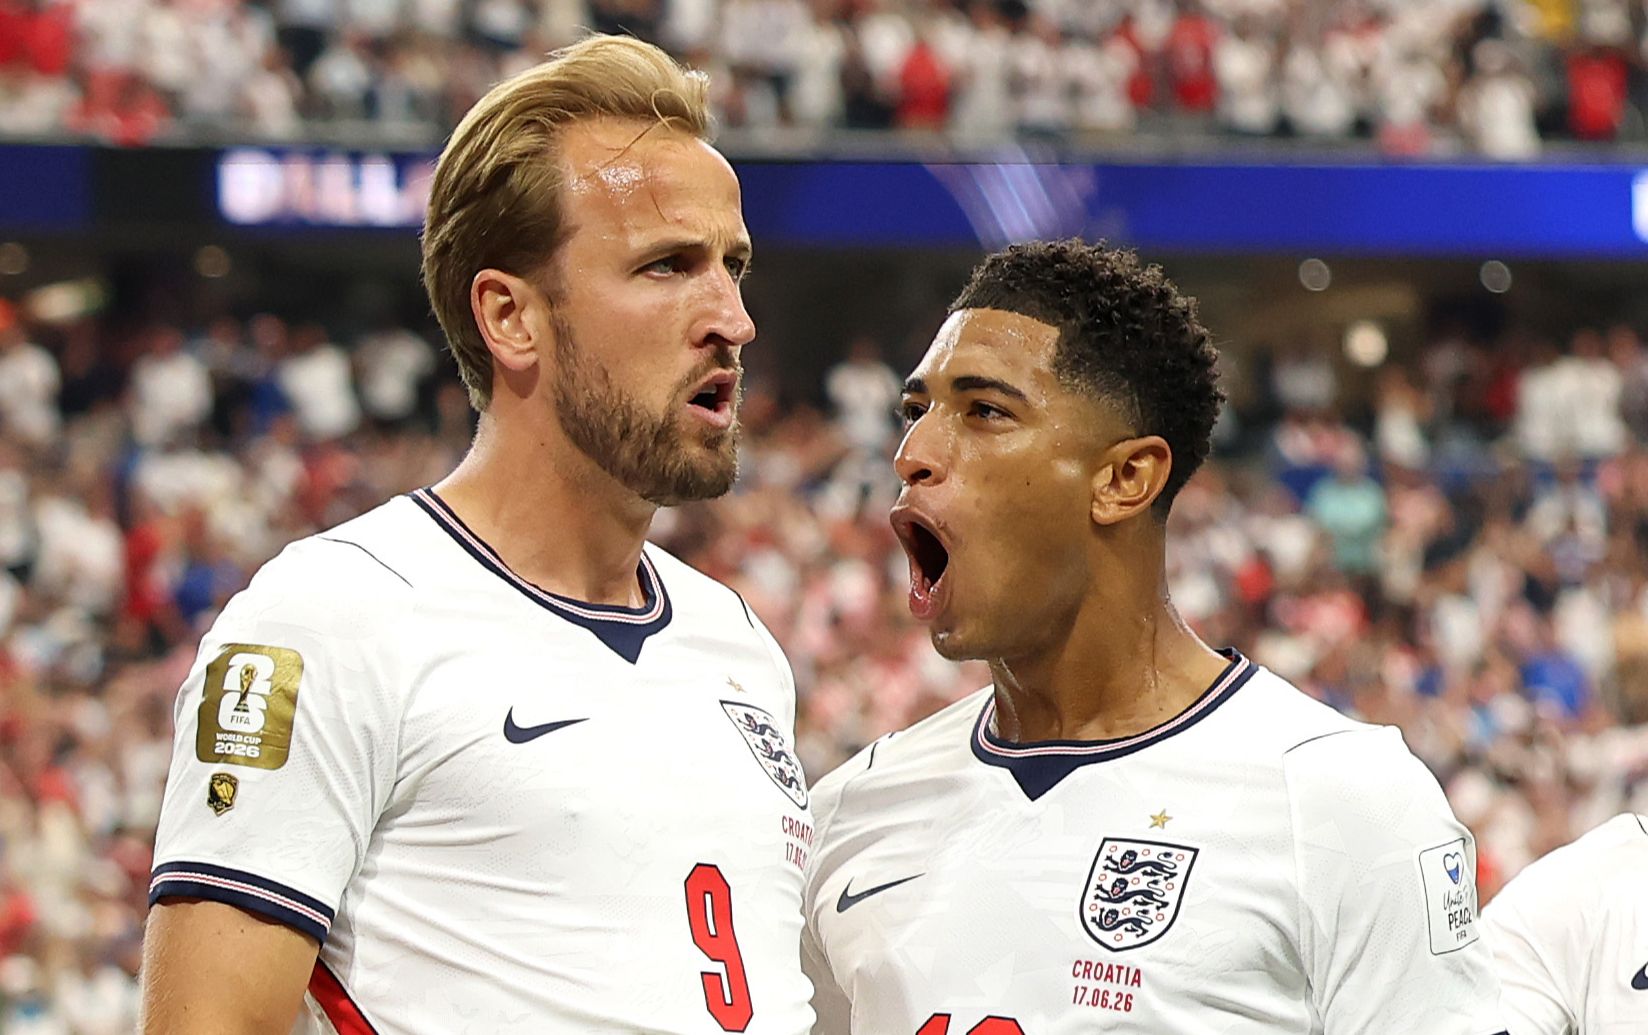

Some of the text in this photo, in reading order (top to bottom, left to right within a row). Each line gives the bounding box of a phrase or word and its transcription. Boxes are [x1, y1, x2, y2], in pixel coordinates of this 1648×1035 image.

[230, 715, 251, 725] FIFA
[216, 732, 262, 745] WORLD CUP
[214, 742, 260, 758] 2026
[684, 862, 753, 1033] 9
[1072, 959, 1141, 988] CROATIA
[1073, 985, 1133, 1012] 17.06.26
